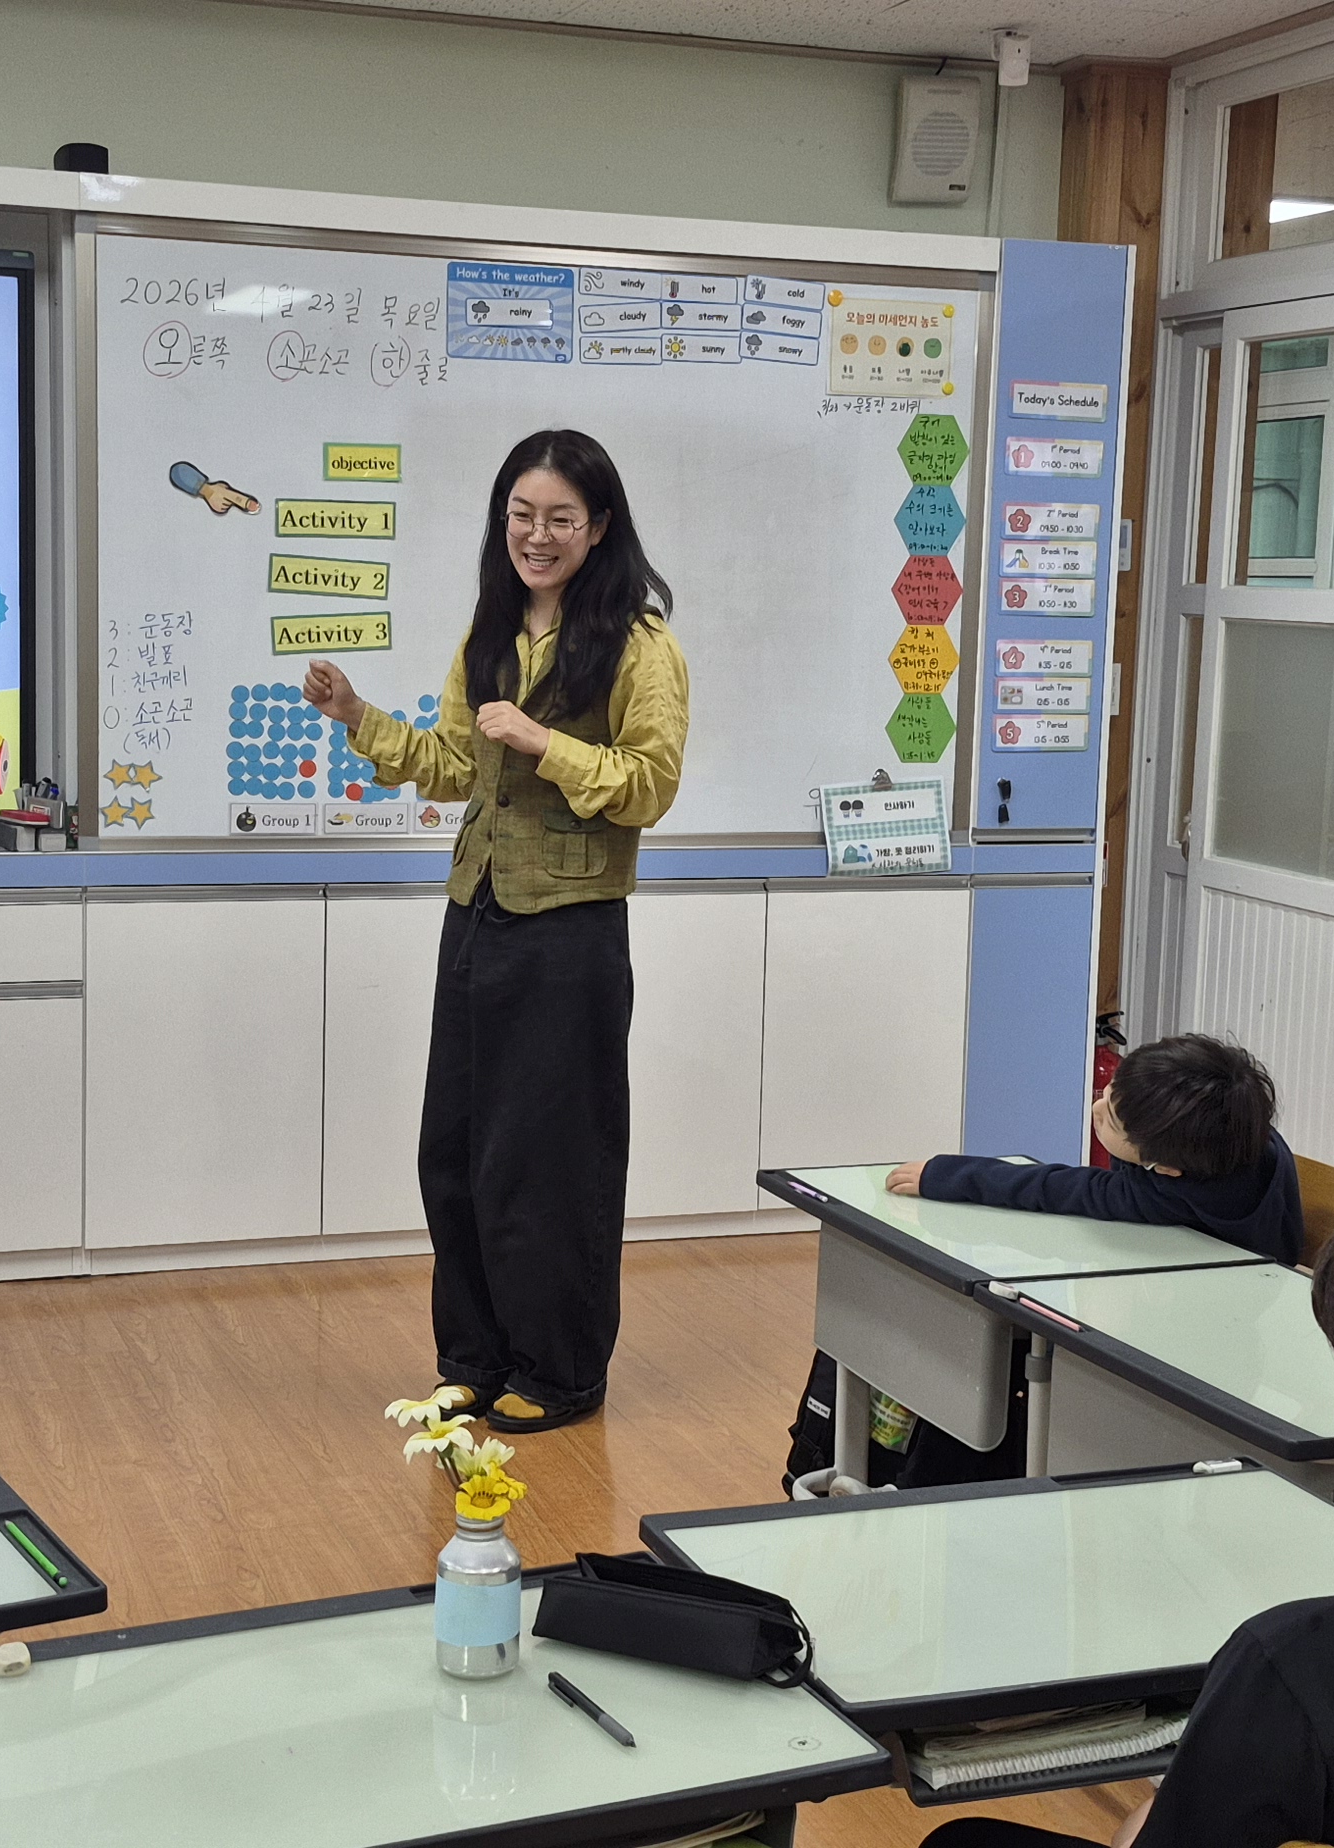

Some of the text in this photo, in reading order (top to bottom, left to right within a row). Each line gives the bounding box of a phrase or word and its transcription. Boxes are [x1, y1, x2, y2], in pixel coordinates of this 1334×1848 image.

[456, 267, 565, 284] How's the weather?
[620, 279, 645, 291] windy
[701, 285, 716, 295] hot
[787, 288, 805, 299] cold
[120, 277, 226, 312] 2026년
[381, 296, 440, 330] 목요일
[509, 307, 532, 319] rainy
[619, 311, 647, 323] cloudy
[697, 313, 729, 324] stormy
[846, 311, 939, 329] 오늘의 미세먼지 농도
[782, 316, 806, 330] foggy
[155, 328, 230, 369] 오른쪽
[276, 339, 349, 375] 소곤소곤
[701, 345, 725, 356] sunny
[778, 346, 803, 358] snowy
[1018, 392, 1099, 408] Today's Schedule
[1059, 446, 1080, 454] Period
[331, 456, 395, 472] objective
[281, 509, 390, 532] Activity 1
[1058, 510, 1078, 519] Period
[273, 564, 386, 592] Activity 2
[139, 611, 193, 639] 운동장
[277, 623, 387, 646] Activity 3
[137, 642, 174, 667] 발표
[131, 665, 187, 693] 친구끼리
[1035, 684, 1072, 692] Lunch Time
[123, 727, 171, 754] (독서)
[262, 813, 312, 830] Group 1
[355, 813, 405, 830] Group 2
